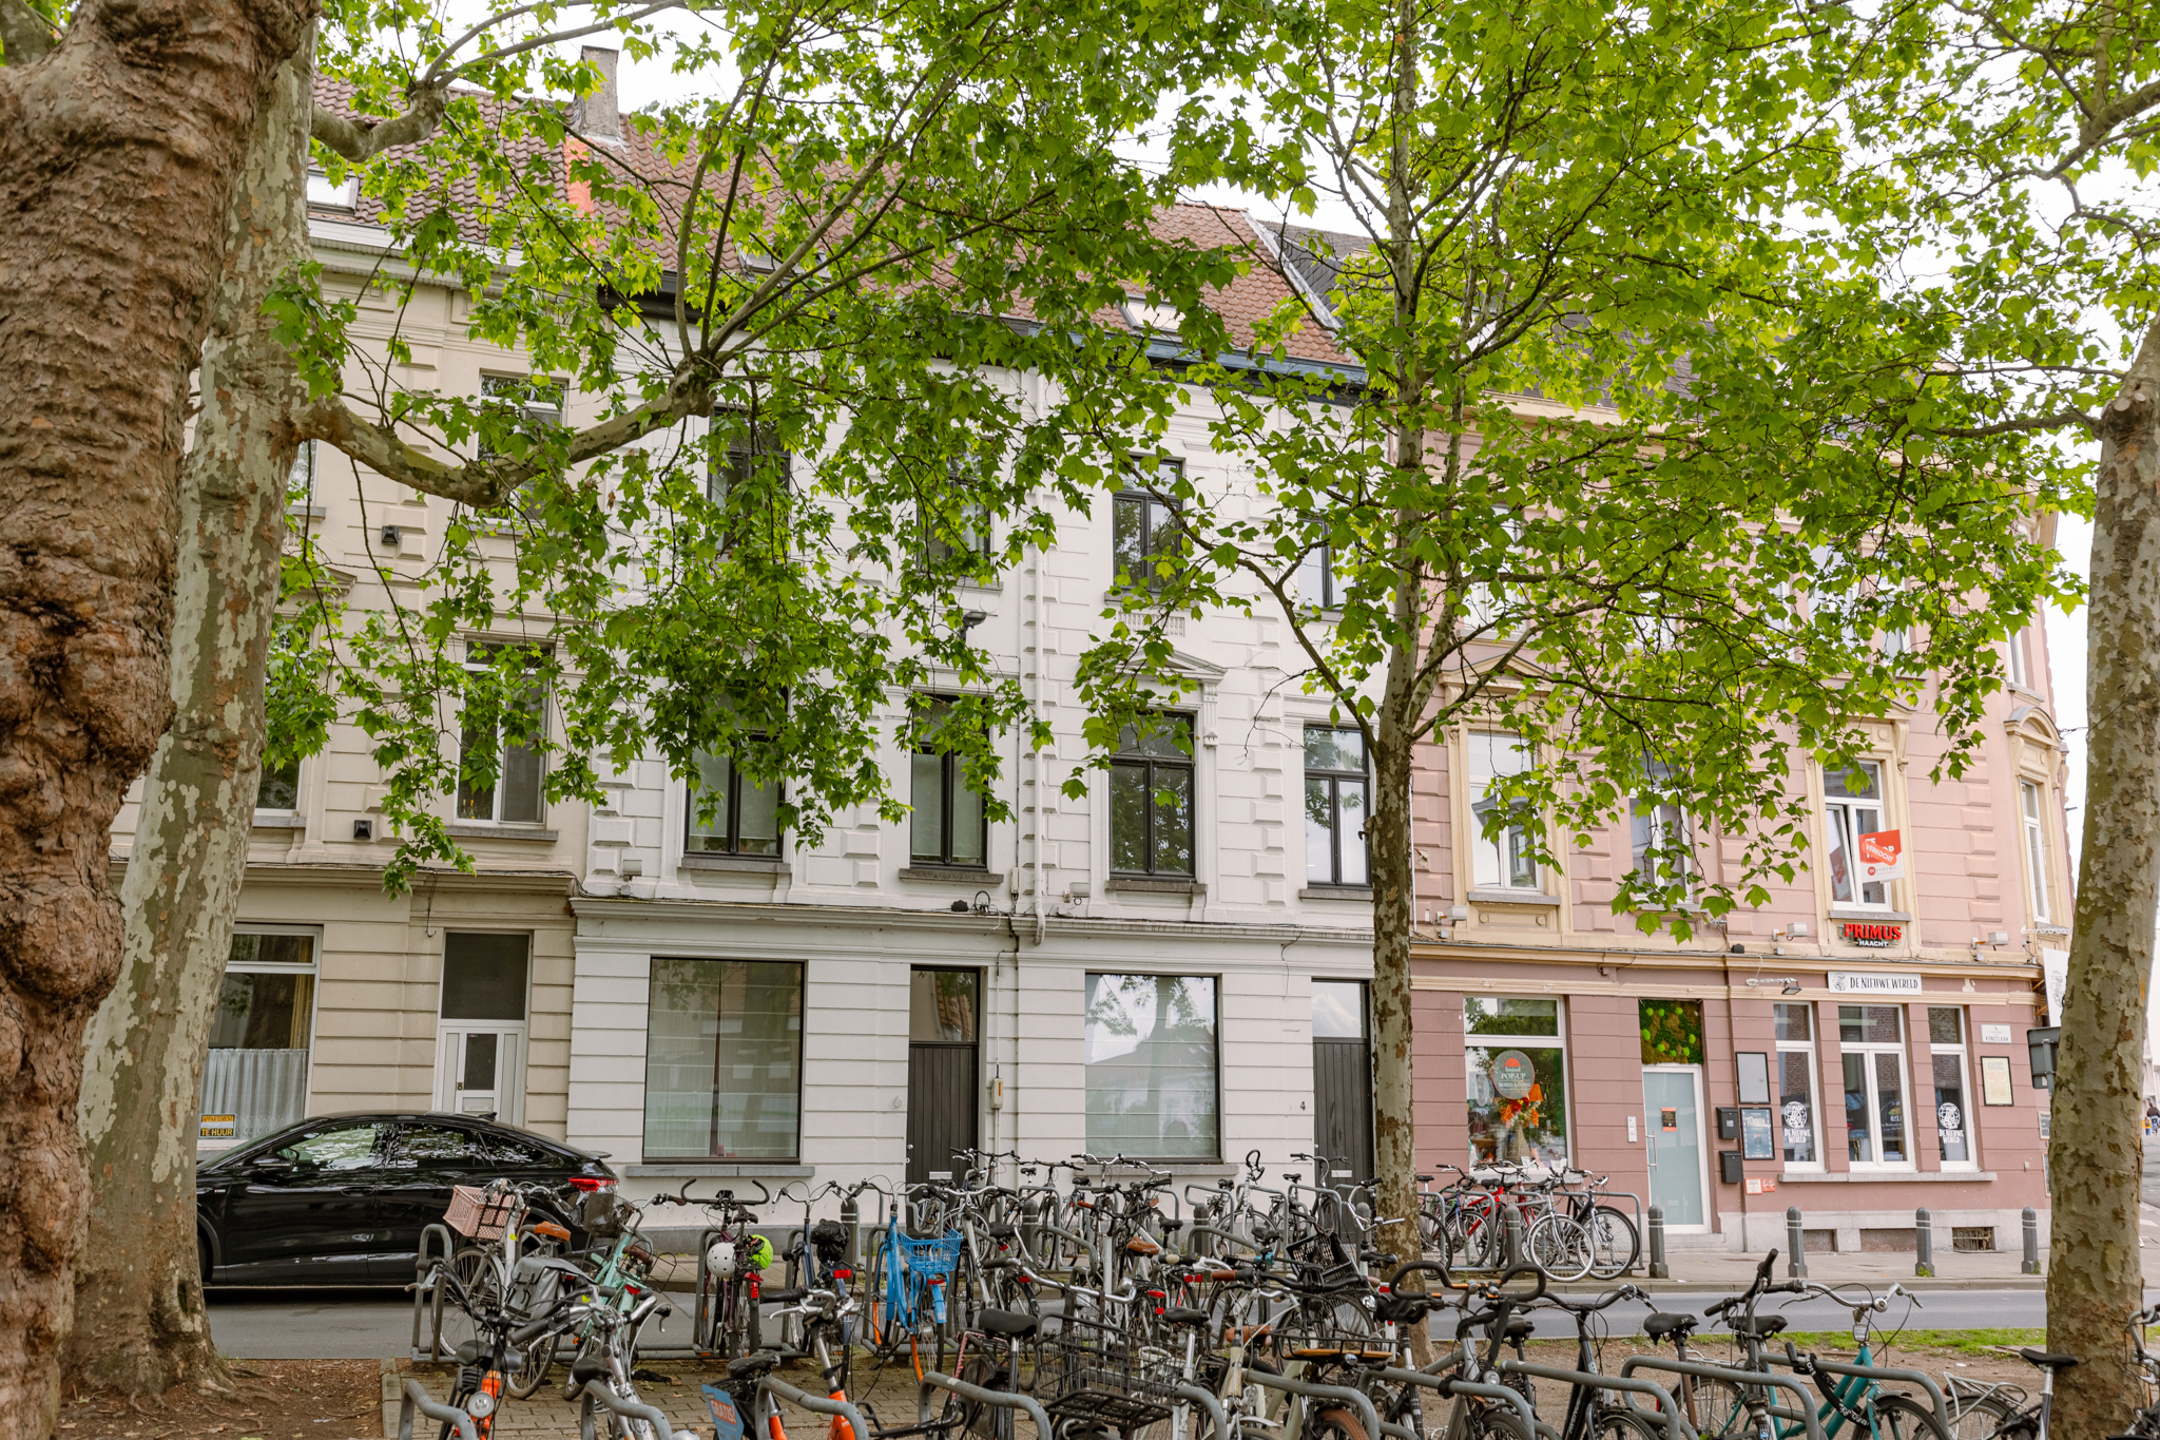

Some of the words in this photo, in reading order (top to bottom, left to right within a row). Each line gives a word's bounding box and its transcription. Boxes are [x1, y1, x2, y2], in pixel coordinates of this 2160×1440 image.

[1866, 843, 1894, 862] VERKOCHT
[1845, 923, 1901, 940] PRIMUS
[1850, 976, 1860, 989] DE
[1861, 976, 1891, 989] NIEUWE
[1891, 978, 1919, 989] WERELD
[1501, 1072, 1526, 1080] POP-UP
[457, 1082, 463, 1091] 8
[893, 1095, 903, 1109] 6
[1300, 1101, 1306, 1111] 4
[201, 1128, 210, 1136] TE
[1784, 1129, 1792, 1137] DE
[1938, 1129, 1946, 1137] DE
[1788, 1136, 1807, 1144] WERELD
[1942, 1136, 1960, 1144] WERELD
[710, 1400, 737, 1423] GRATIS!
